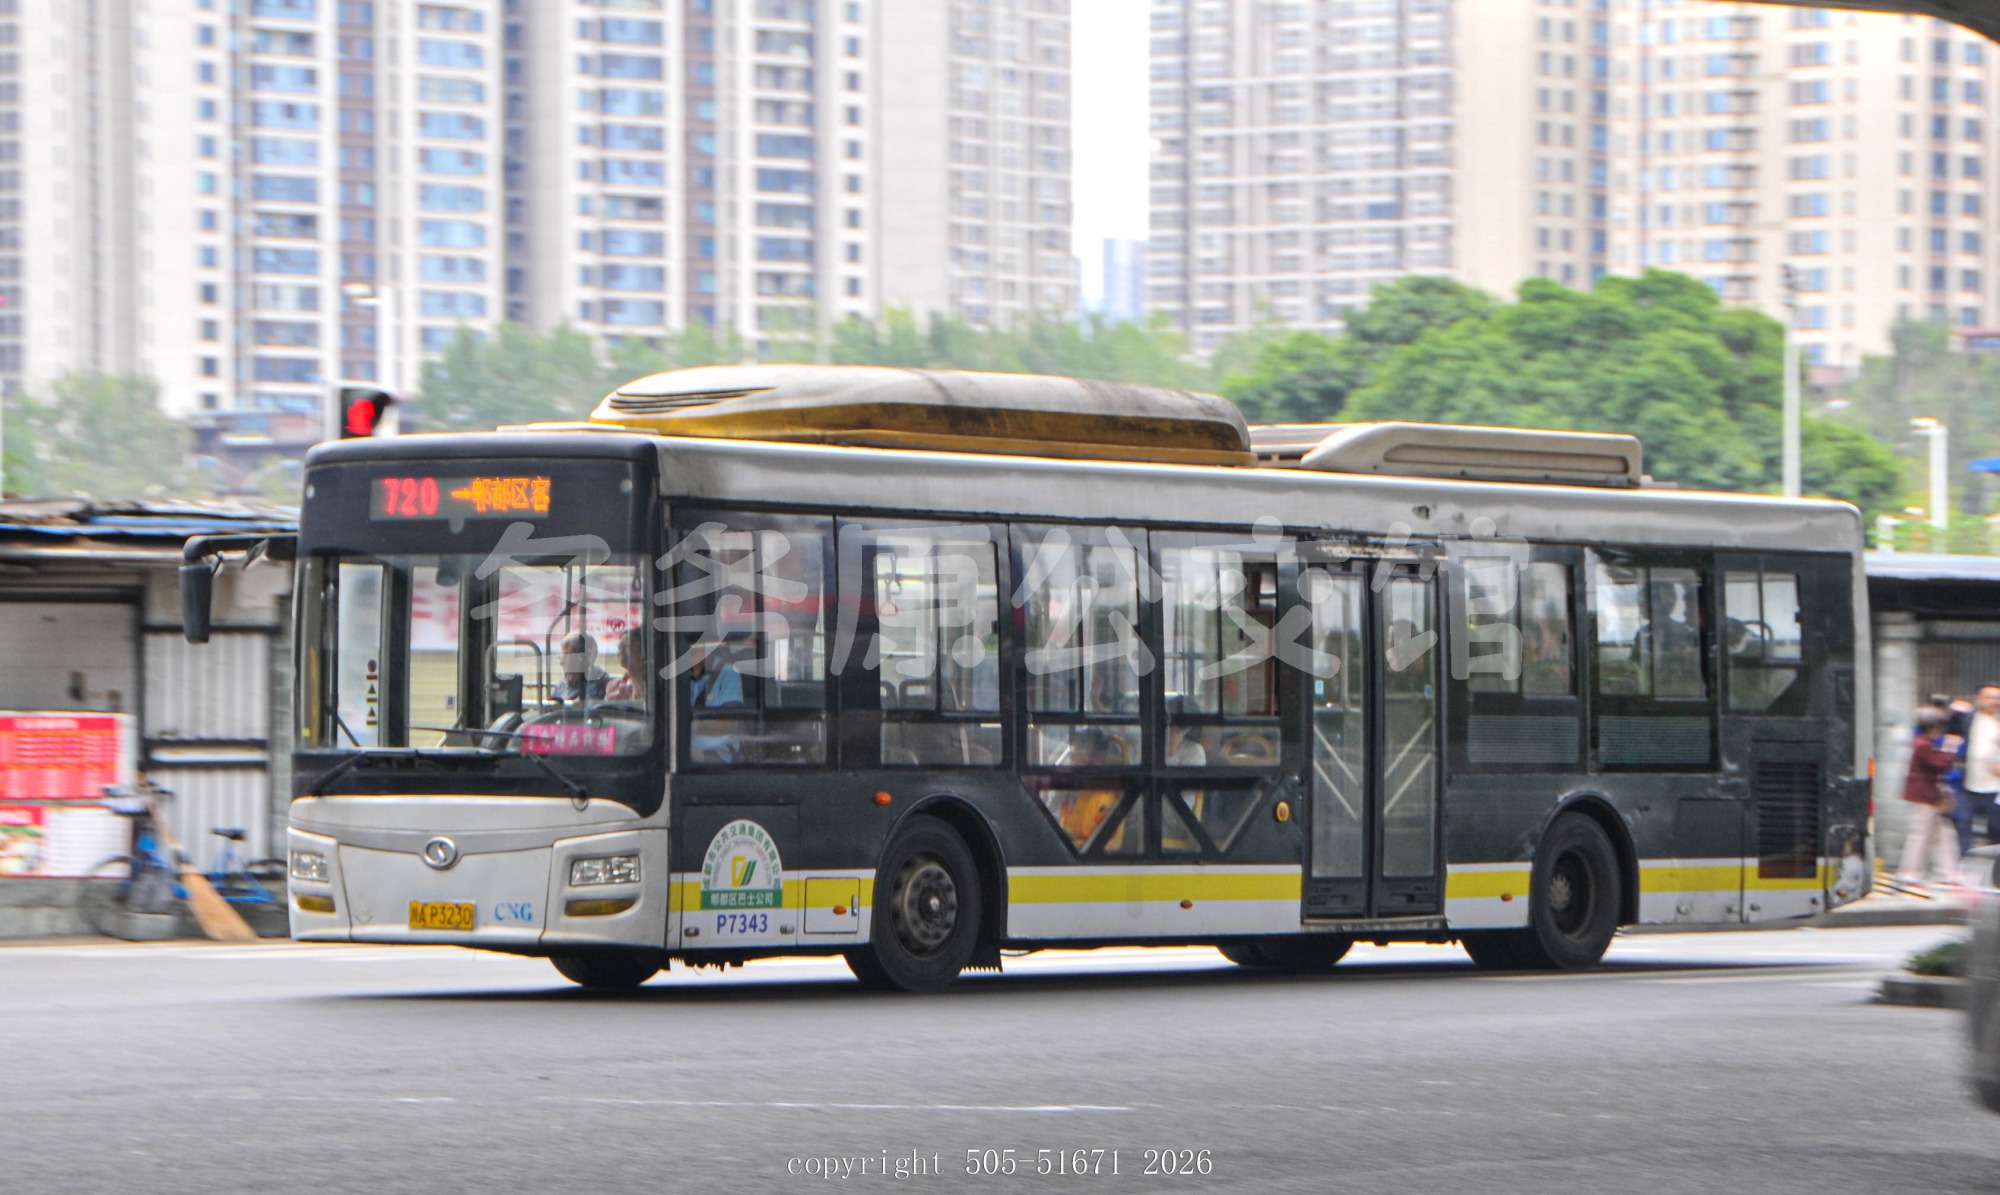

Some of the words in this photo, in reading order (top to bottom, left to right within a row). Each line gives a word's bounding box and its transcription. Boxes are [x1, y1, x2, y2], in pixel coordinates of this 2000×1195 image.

[383, 475, 439, 516] 720
[494, 903, 532, 921] CNG
[717, 913, 768, 934] P7343
